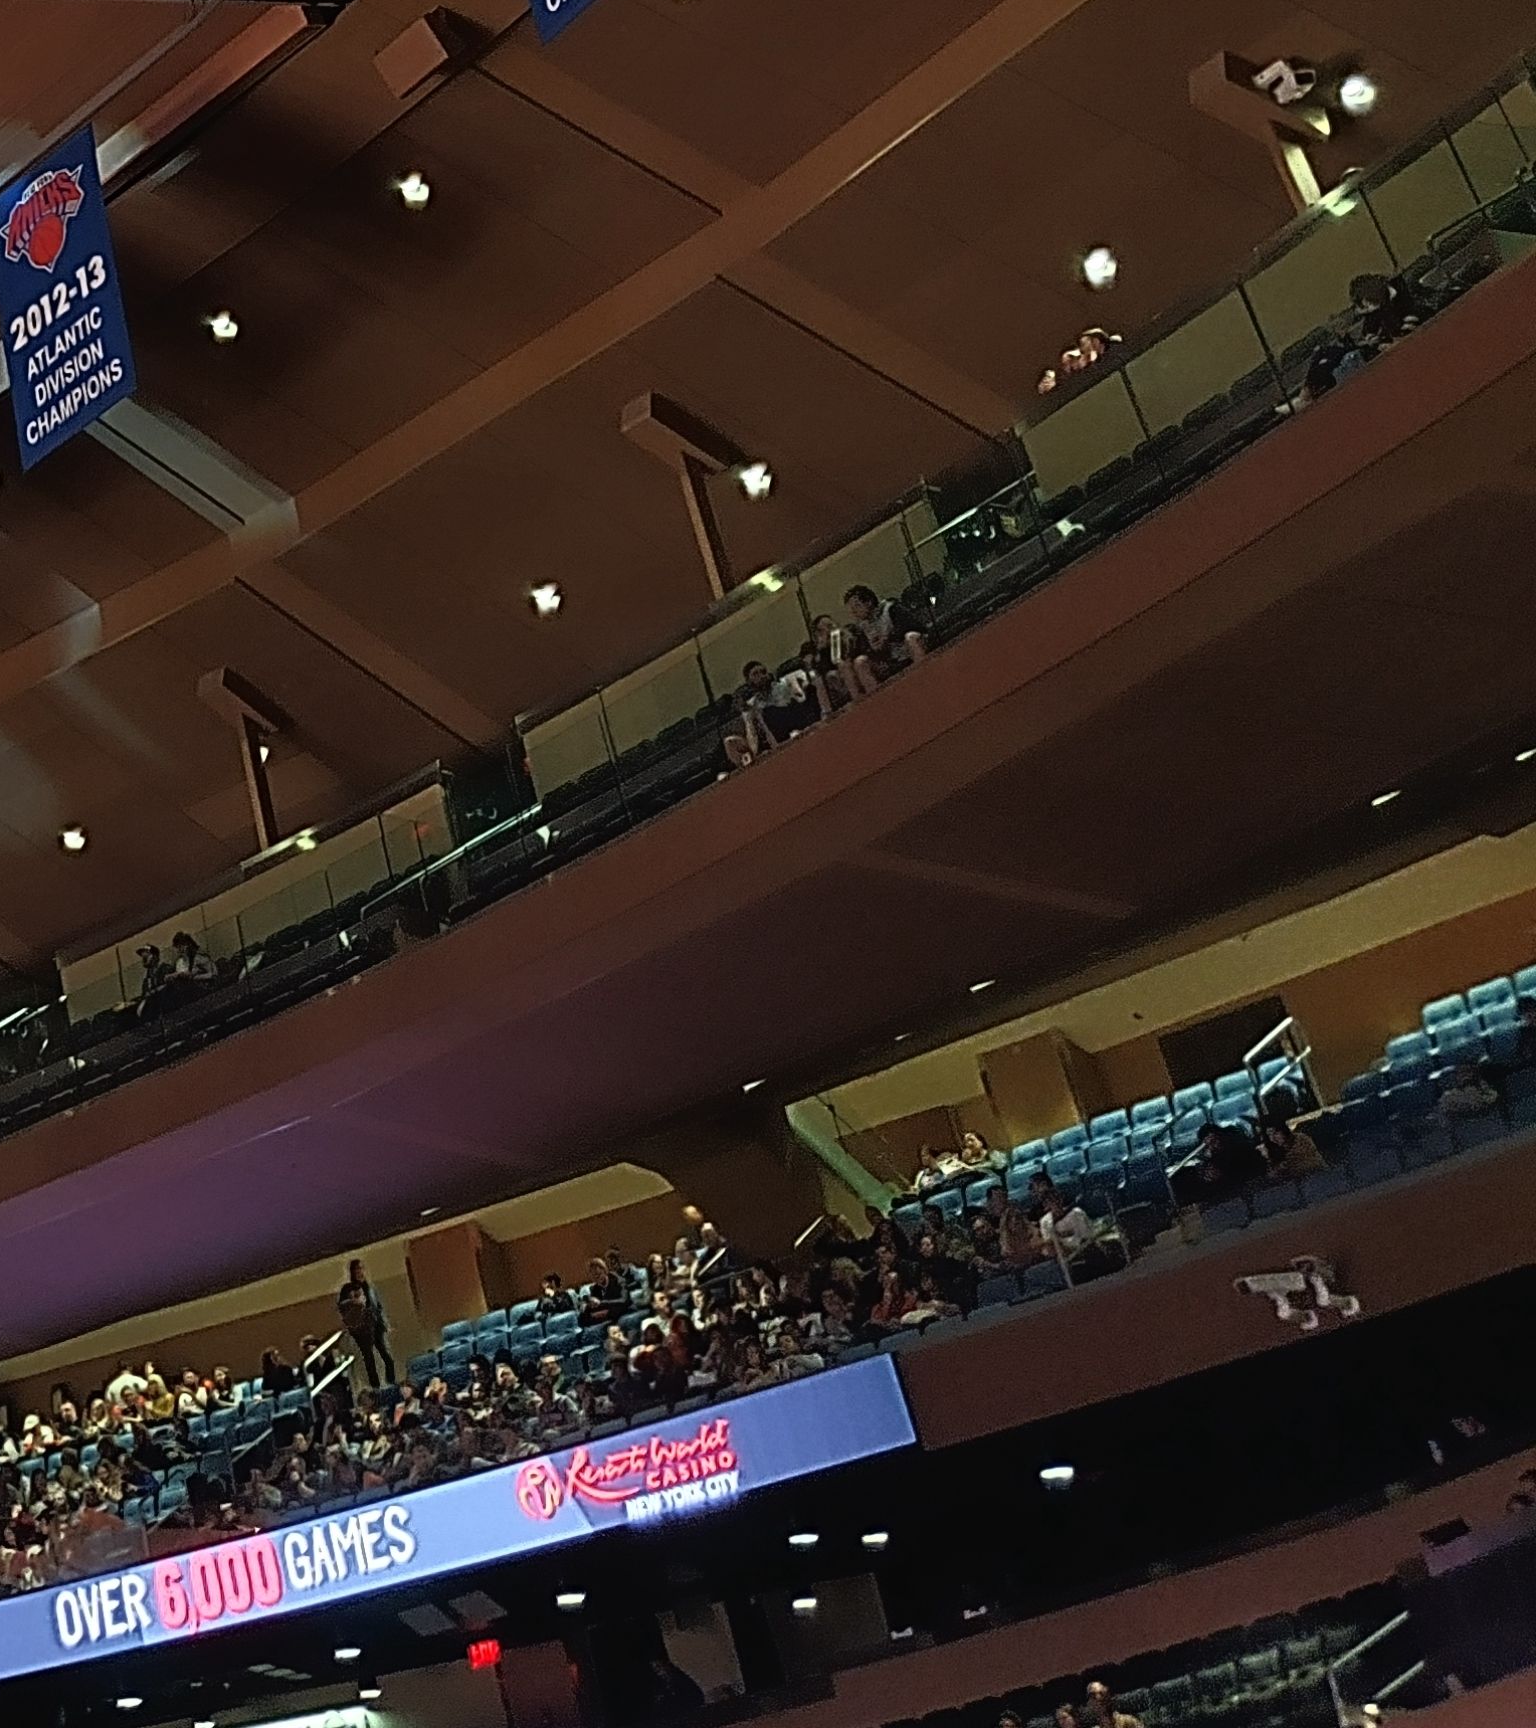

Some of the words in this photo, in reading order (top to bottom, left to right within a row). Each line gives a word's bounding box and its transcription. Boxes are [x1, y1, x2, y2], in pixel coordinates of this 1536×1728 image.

[6, 170, 85, 257] KNICKS
[10, 254, 106, 352] 2012-13
[28, 306, 103, 381] ATLANTIC
[27, 358, 123, 445] CHAMPIONS
[35, 338, 104, 407] DIVISION
[566, 1446, 648, 1503] Resorts
[649, 1417, 728, 1466] World
[625, 1494, 663, 1520] NEW
[664, 1483, 705, 1513] YORK
[706, 1471, 740, 1500] CITY
[645, 1450, 737, 1491] CASINO
[54, 1572, 152, 1648] OVER
[153, 1536, 283, 1634] 6,000
[282, 1504, 417, 1591] GAMES
